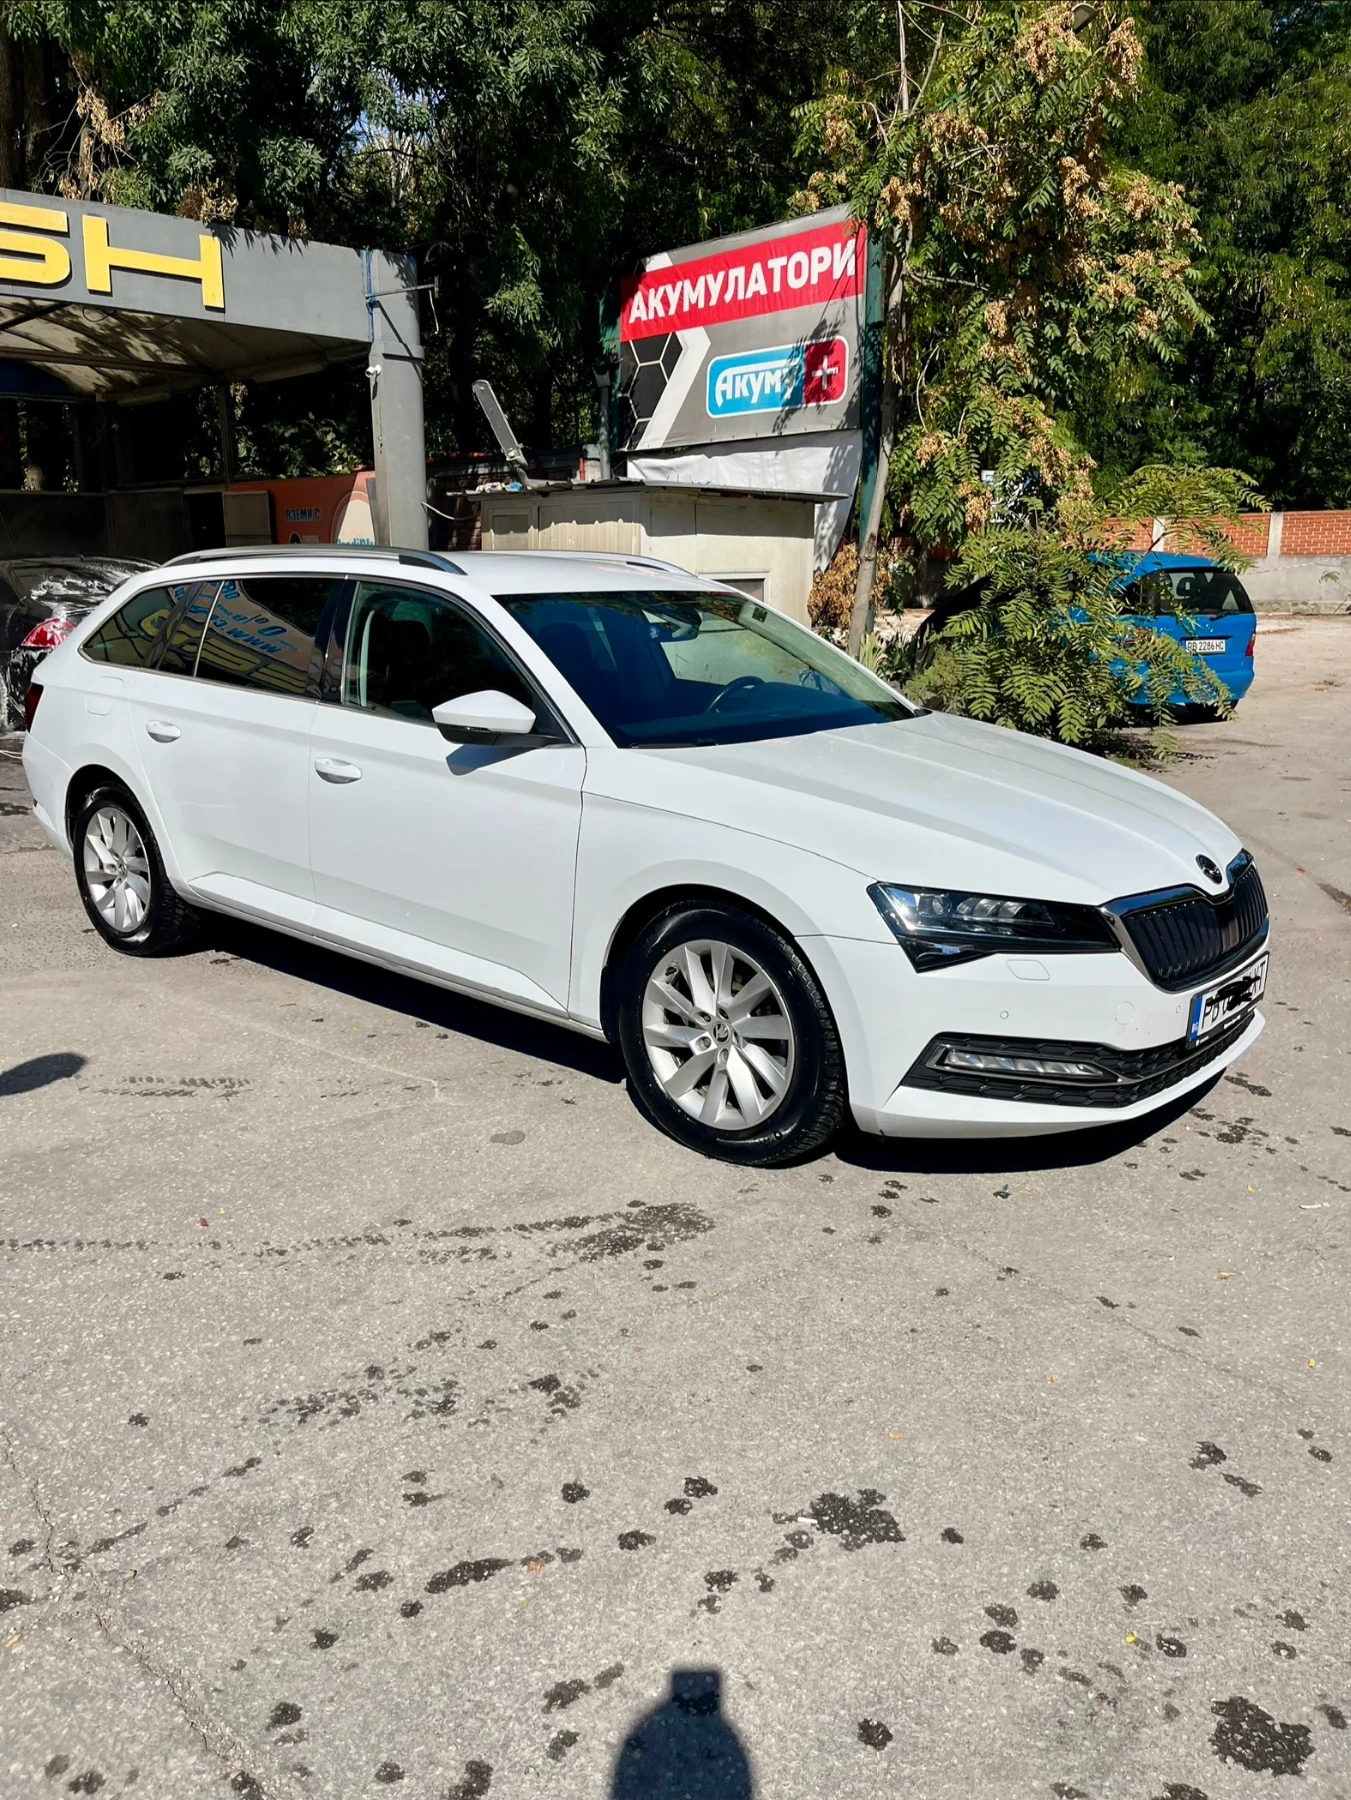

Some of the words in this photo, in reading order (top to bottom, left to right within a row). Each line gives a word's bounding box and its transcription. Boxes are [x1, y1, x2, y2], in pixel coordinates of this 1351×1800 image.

[628, 238, 856, 324] АКУМУЛАТОРИ
[1199, 641, 1215, 651] 2286
[1216, 641, 1224, 651] HC
